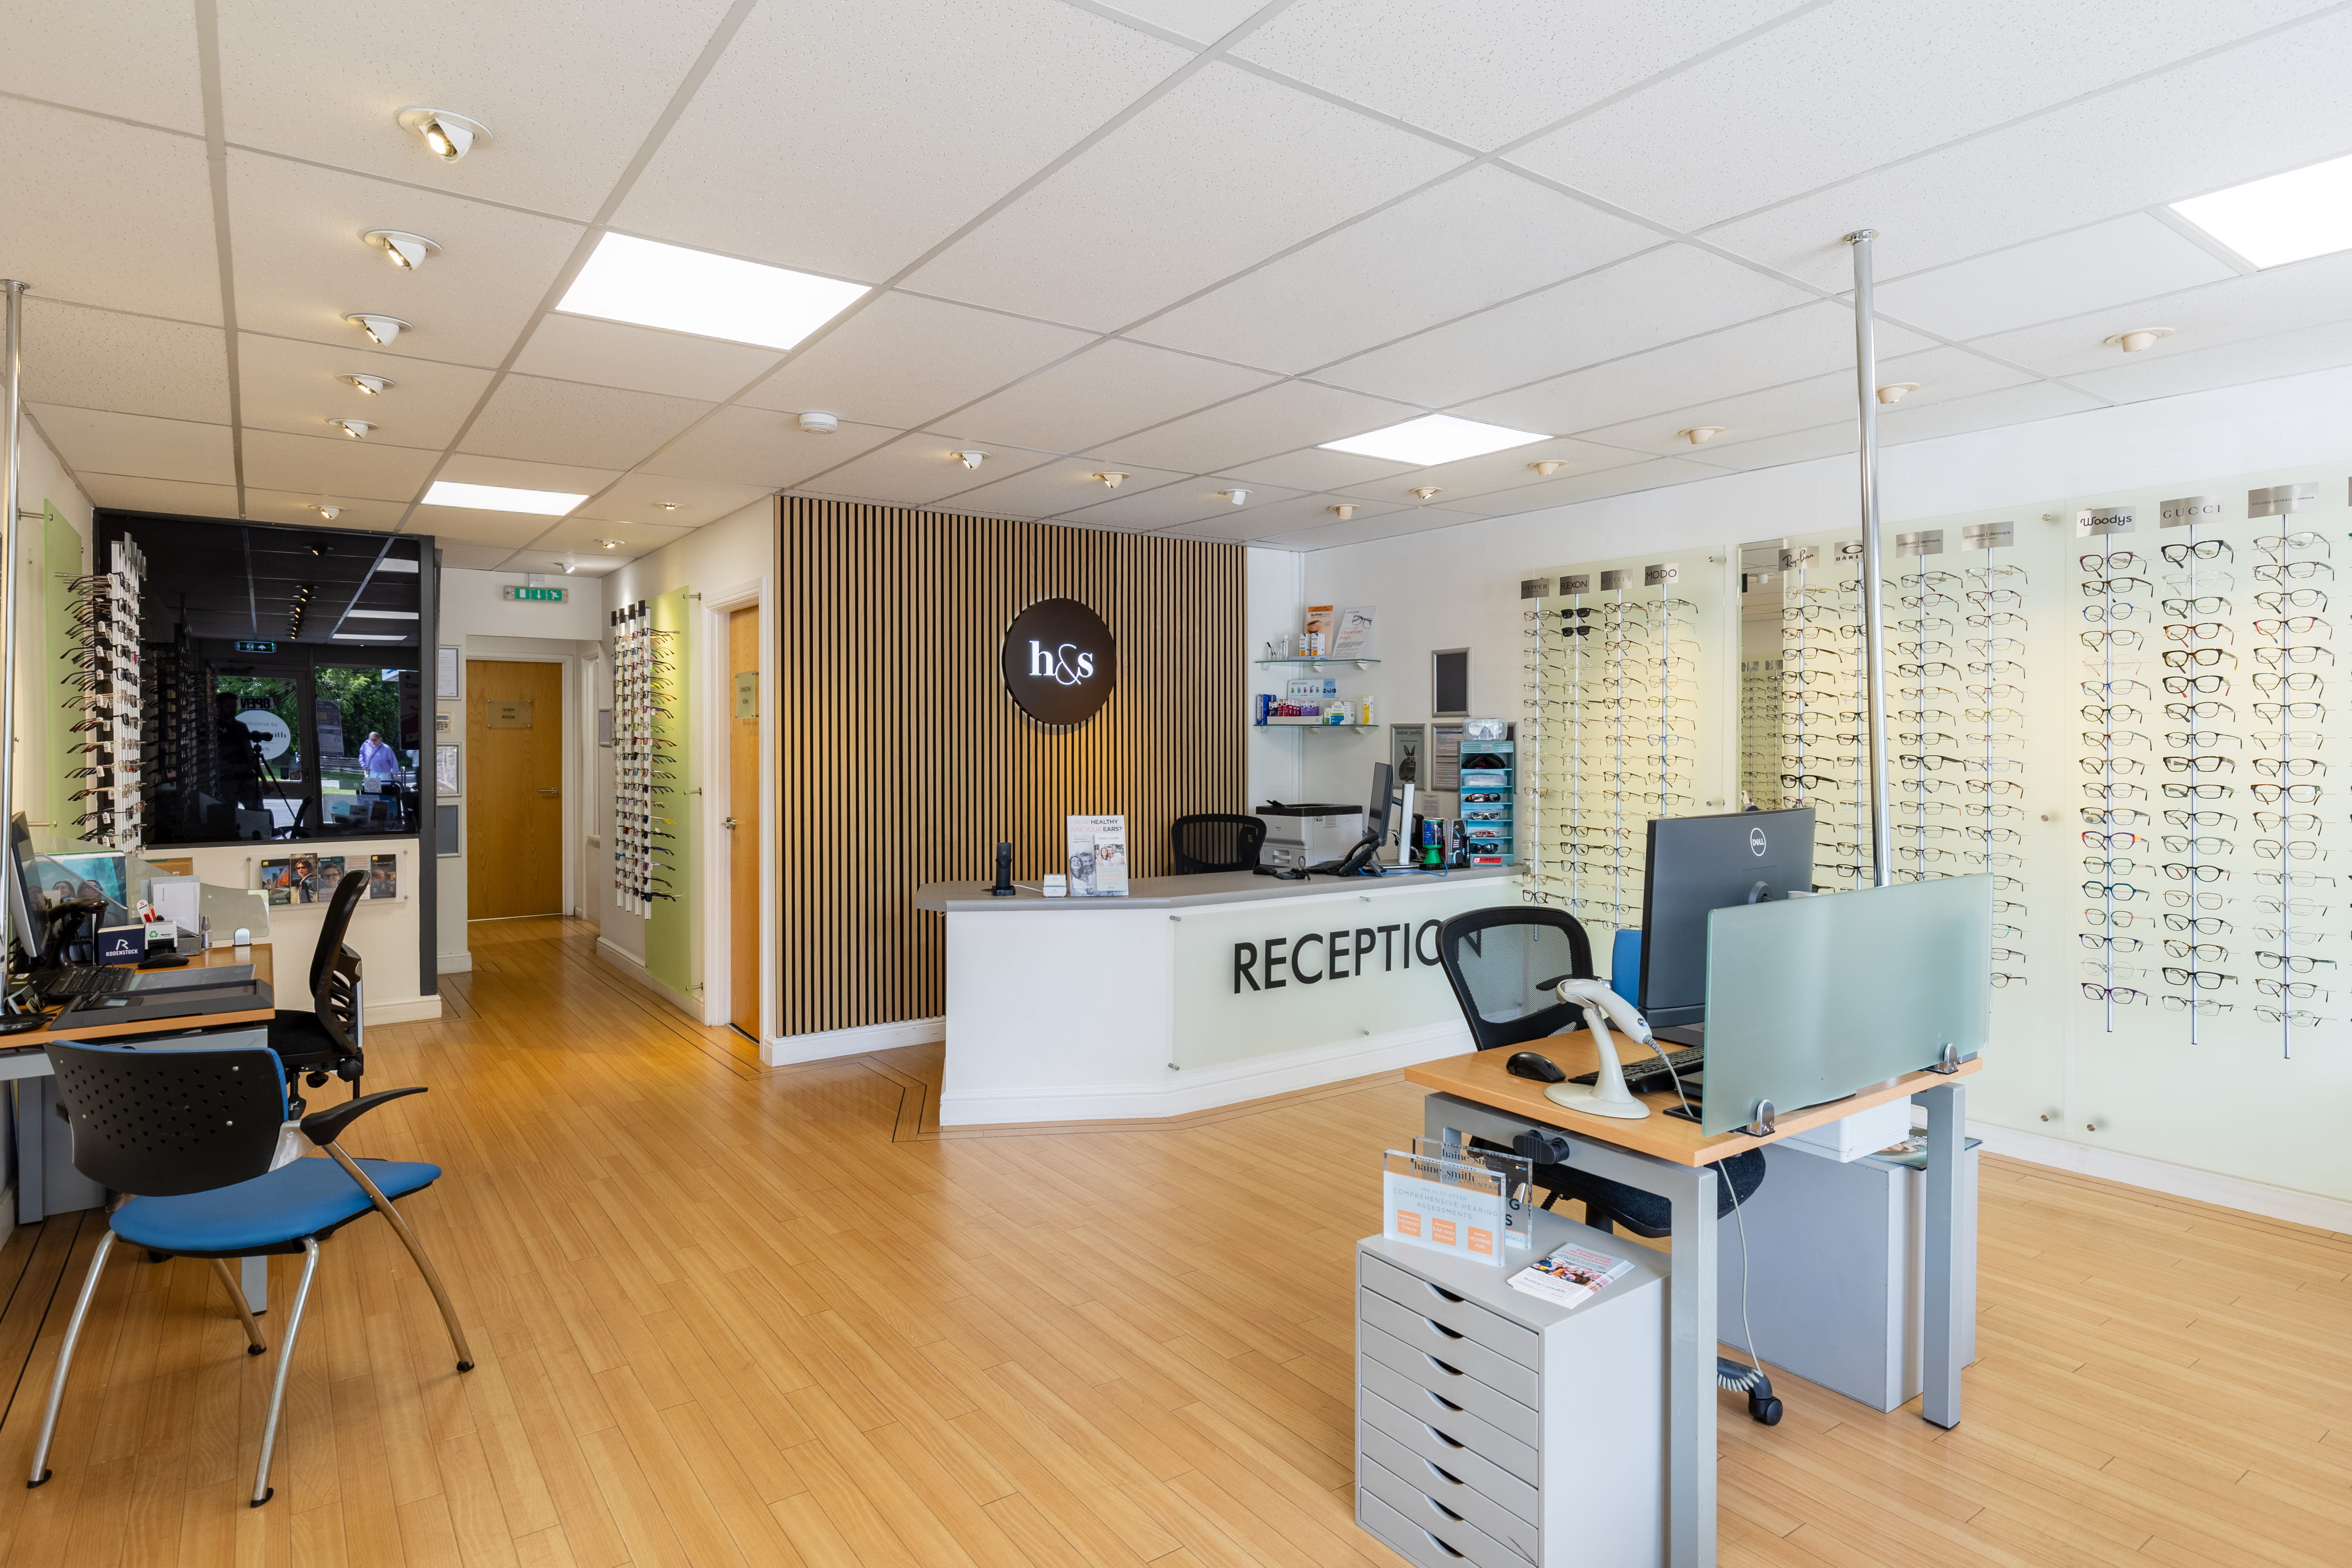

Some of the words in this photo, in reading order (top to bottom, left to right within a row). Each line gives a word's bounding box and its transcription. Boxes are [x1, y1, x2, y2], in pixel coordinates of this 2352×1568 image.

[2163, 505, 2221, 519] GUCCI
[2080, 514, 2132, 528] Woodys
[1602, 576, 1631, 584] NIFTIES
[1646, 569, 1677, 580] MODO
[1561, 580, 1588, 590] FLEXON
[1029, 640, 1094, 685] h&s
[1752, 838, 1765, 846] DELL
[1437, 1174, 1498, 1191] COMPLIMENTAR
[1393, 1188, 1458, 1208] COMPREHENSIVE
[1462, 1204, 1498, 1217] HEARING
[1417, 1202, 1472, 1219] ASSESSMENTS
[1398, 1218, 1420, 1227] HEARING
[1401, 1224, 1417, 1233] Checks
[1434, 1233, 1454, 1242] Removal
[1469, 1236, 1491, 1246] HEARING
[1561, 1250, 1613, 1267] conversations?
[1576, 1248, 1612, 1261] Struggling
